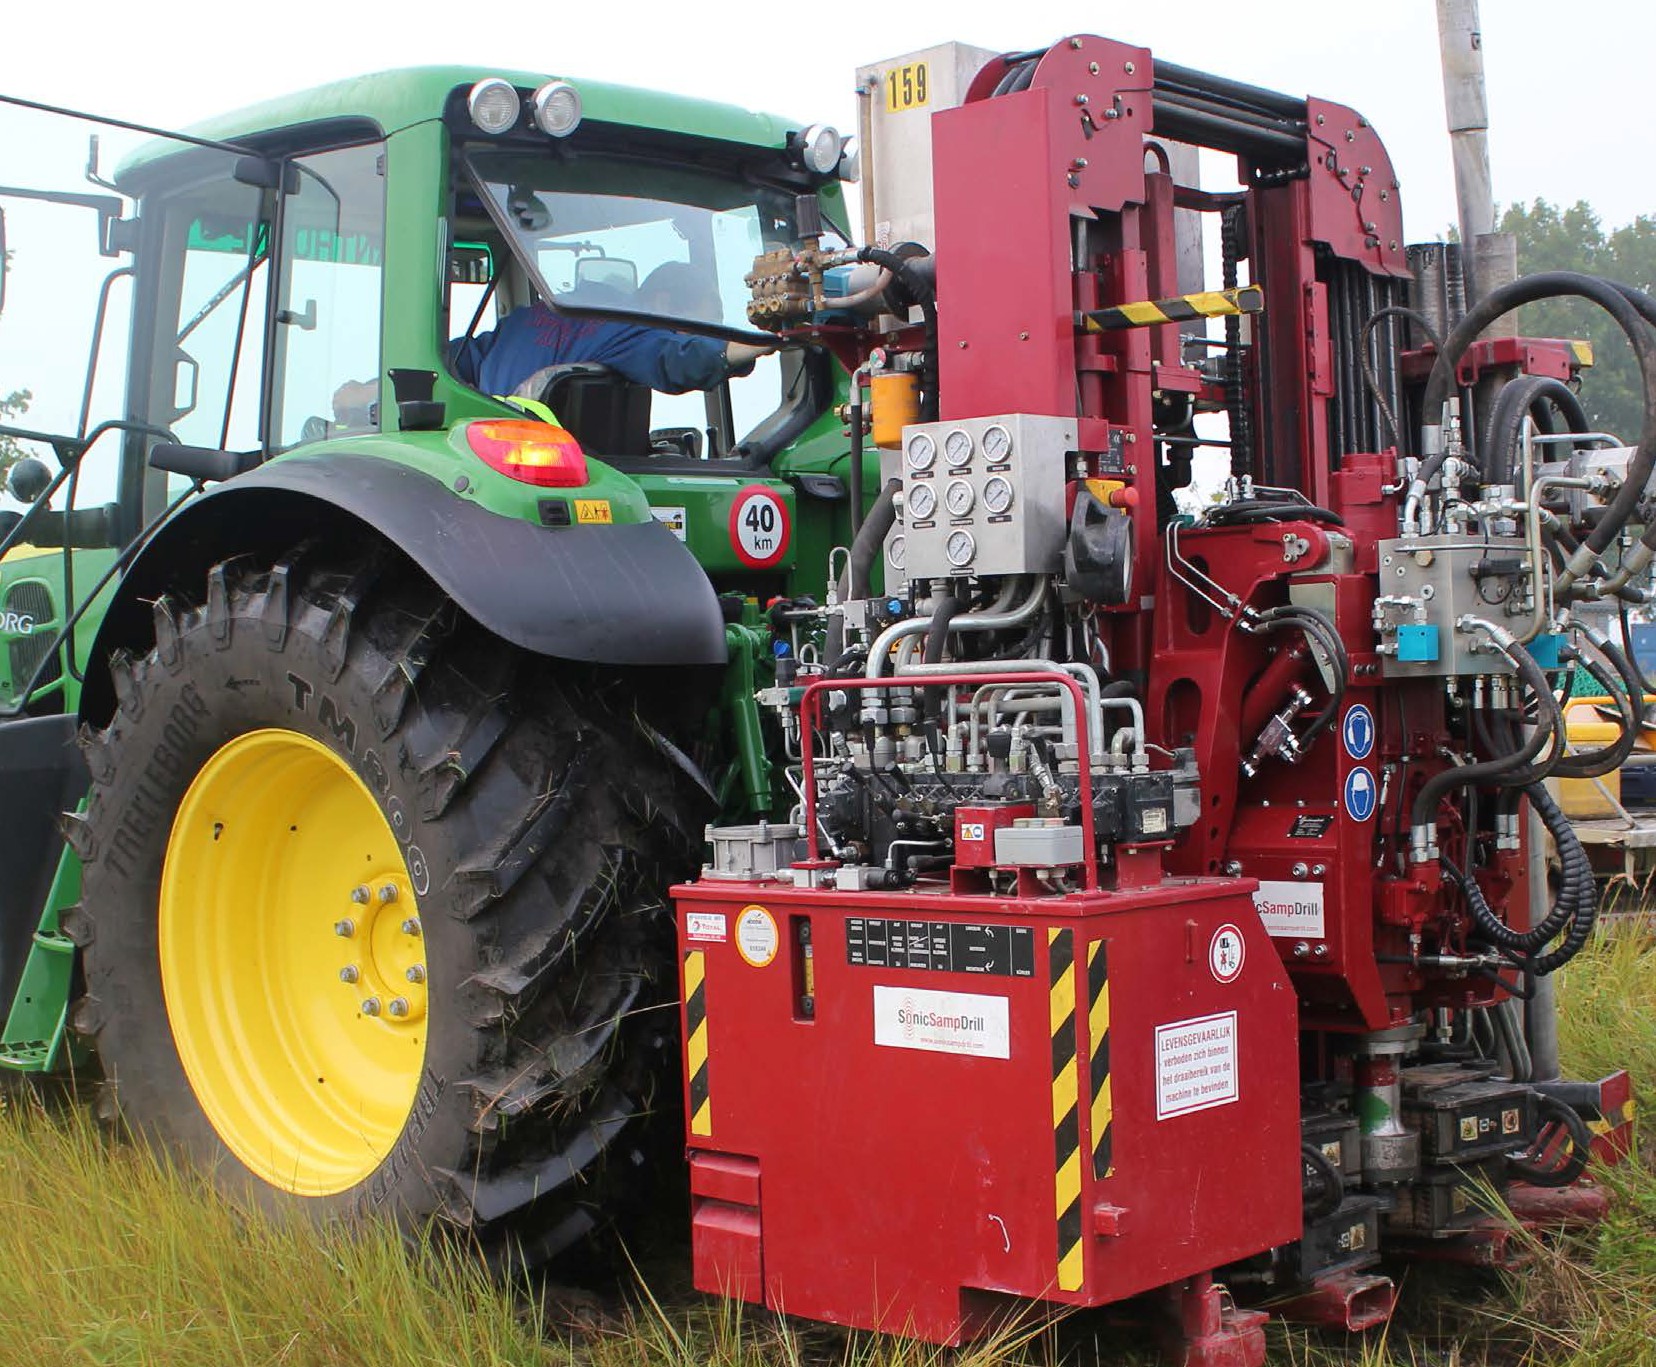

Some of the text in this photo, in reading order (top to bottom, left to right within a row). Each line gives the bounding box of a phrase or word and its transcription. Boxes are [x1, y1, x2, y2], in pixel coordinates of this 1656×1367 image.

[890, 64, 926, 108] 159
[746, 504, 774, 533] 40
[754, 535, 773, 550] km
[103, 680, 212, 879] TRELLEBORG
[1256, 901, 1318, 918] cSampDrill
[898, 1008, 985, 1032] SonicSampDrill
[1161, 1026, 1231, 1051] LEVENSGEVAARLIJK
[1164, 1046, 1229, 1067] verboden zich binnen
[1163, 1062, 1231, 1086] het draaibereik van de
[1166, 1081, 1229, 1103] machine te bevinden
